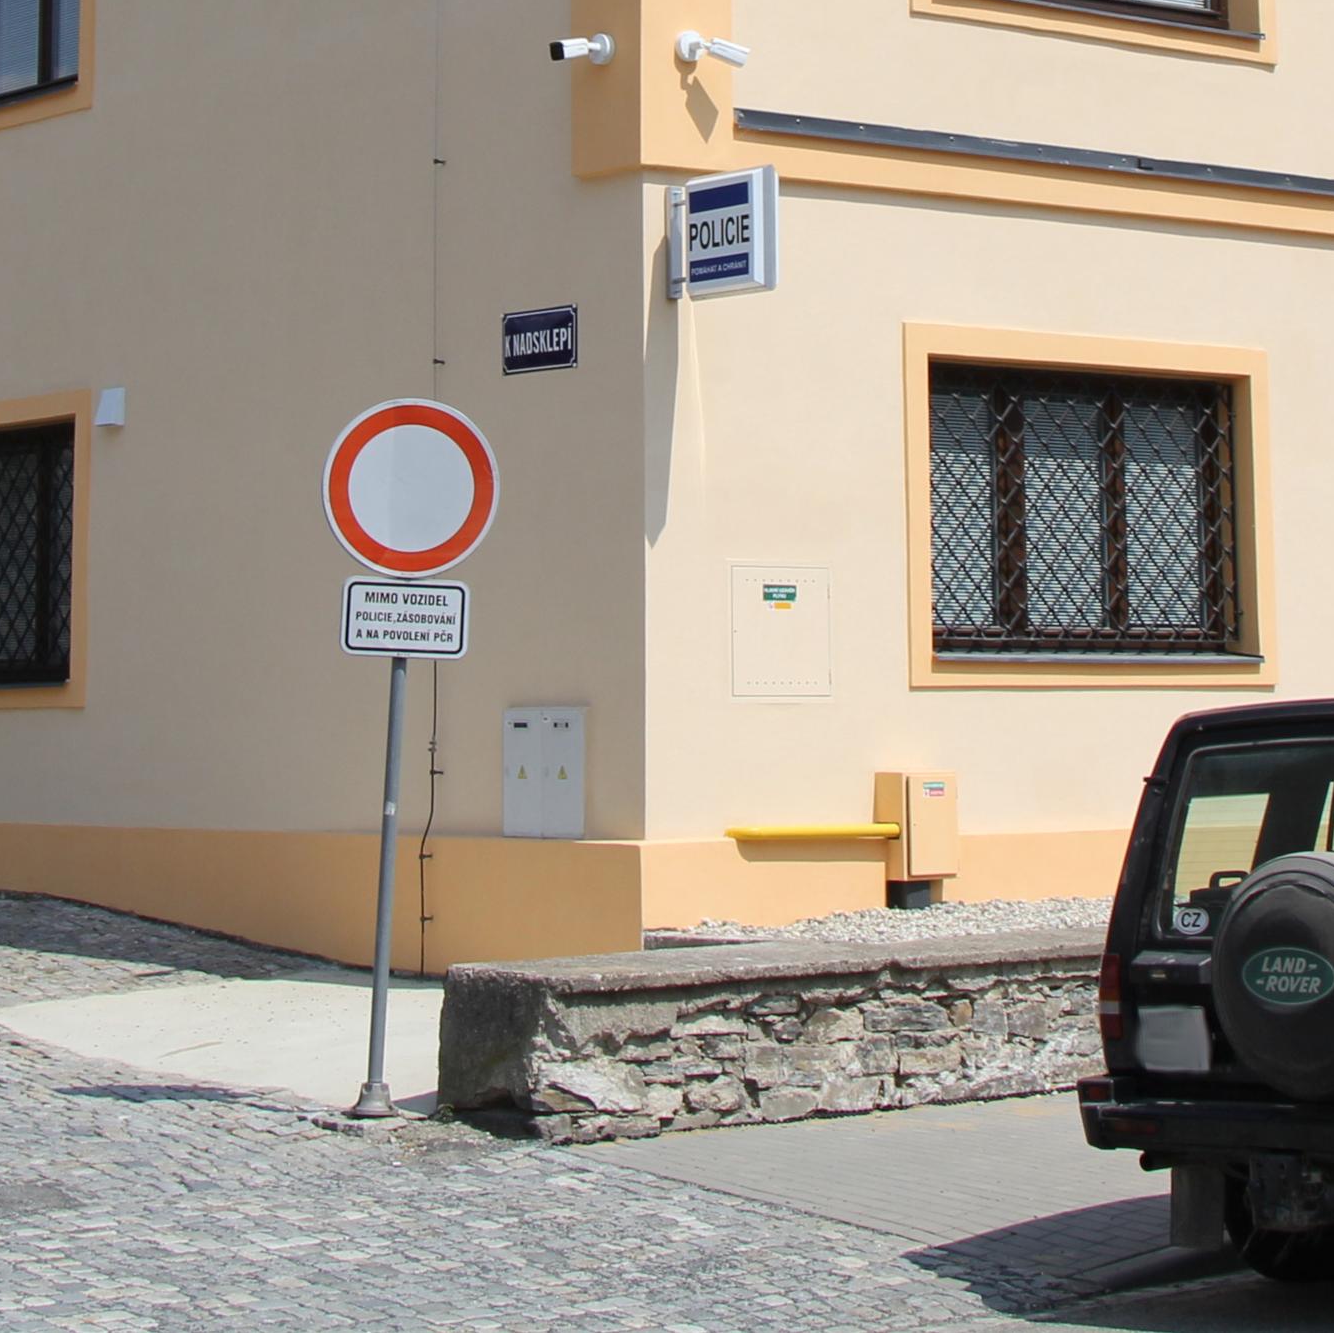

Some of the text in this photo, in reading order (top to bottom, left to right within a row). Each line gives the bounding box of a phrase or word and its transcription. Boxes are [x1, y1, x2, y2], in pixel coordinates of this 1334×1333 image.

[689, 214, 750, 252] POLICIE
[505, 322, 572, 357] K NADSKLEPÍ
[364, 591, 449, 607] MIMO VOZIDEL
[356, 629, 453, 643] A NA POVOLENÍ PČR
[1181, 911, 1201, 928] CZ
